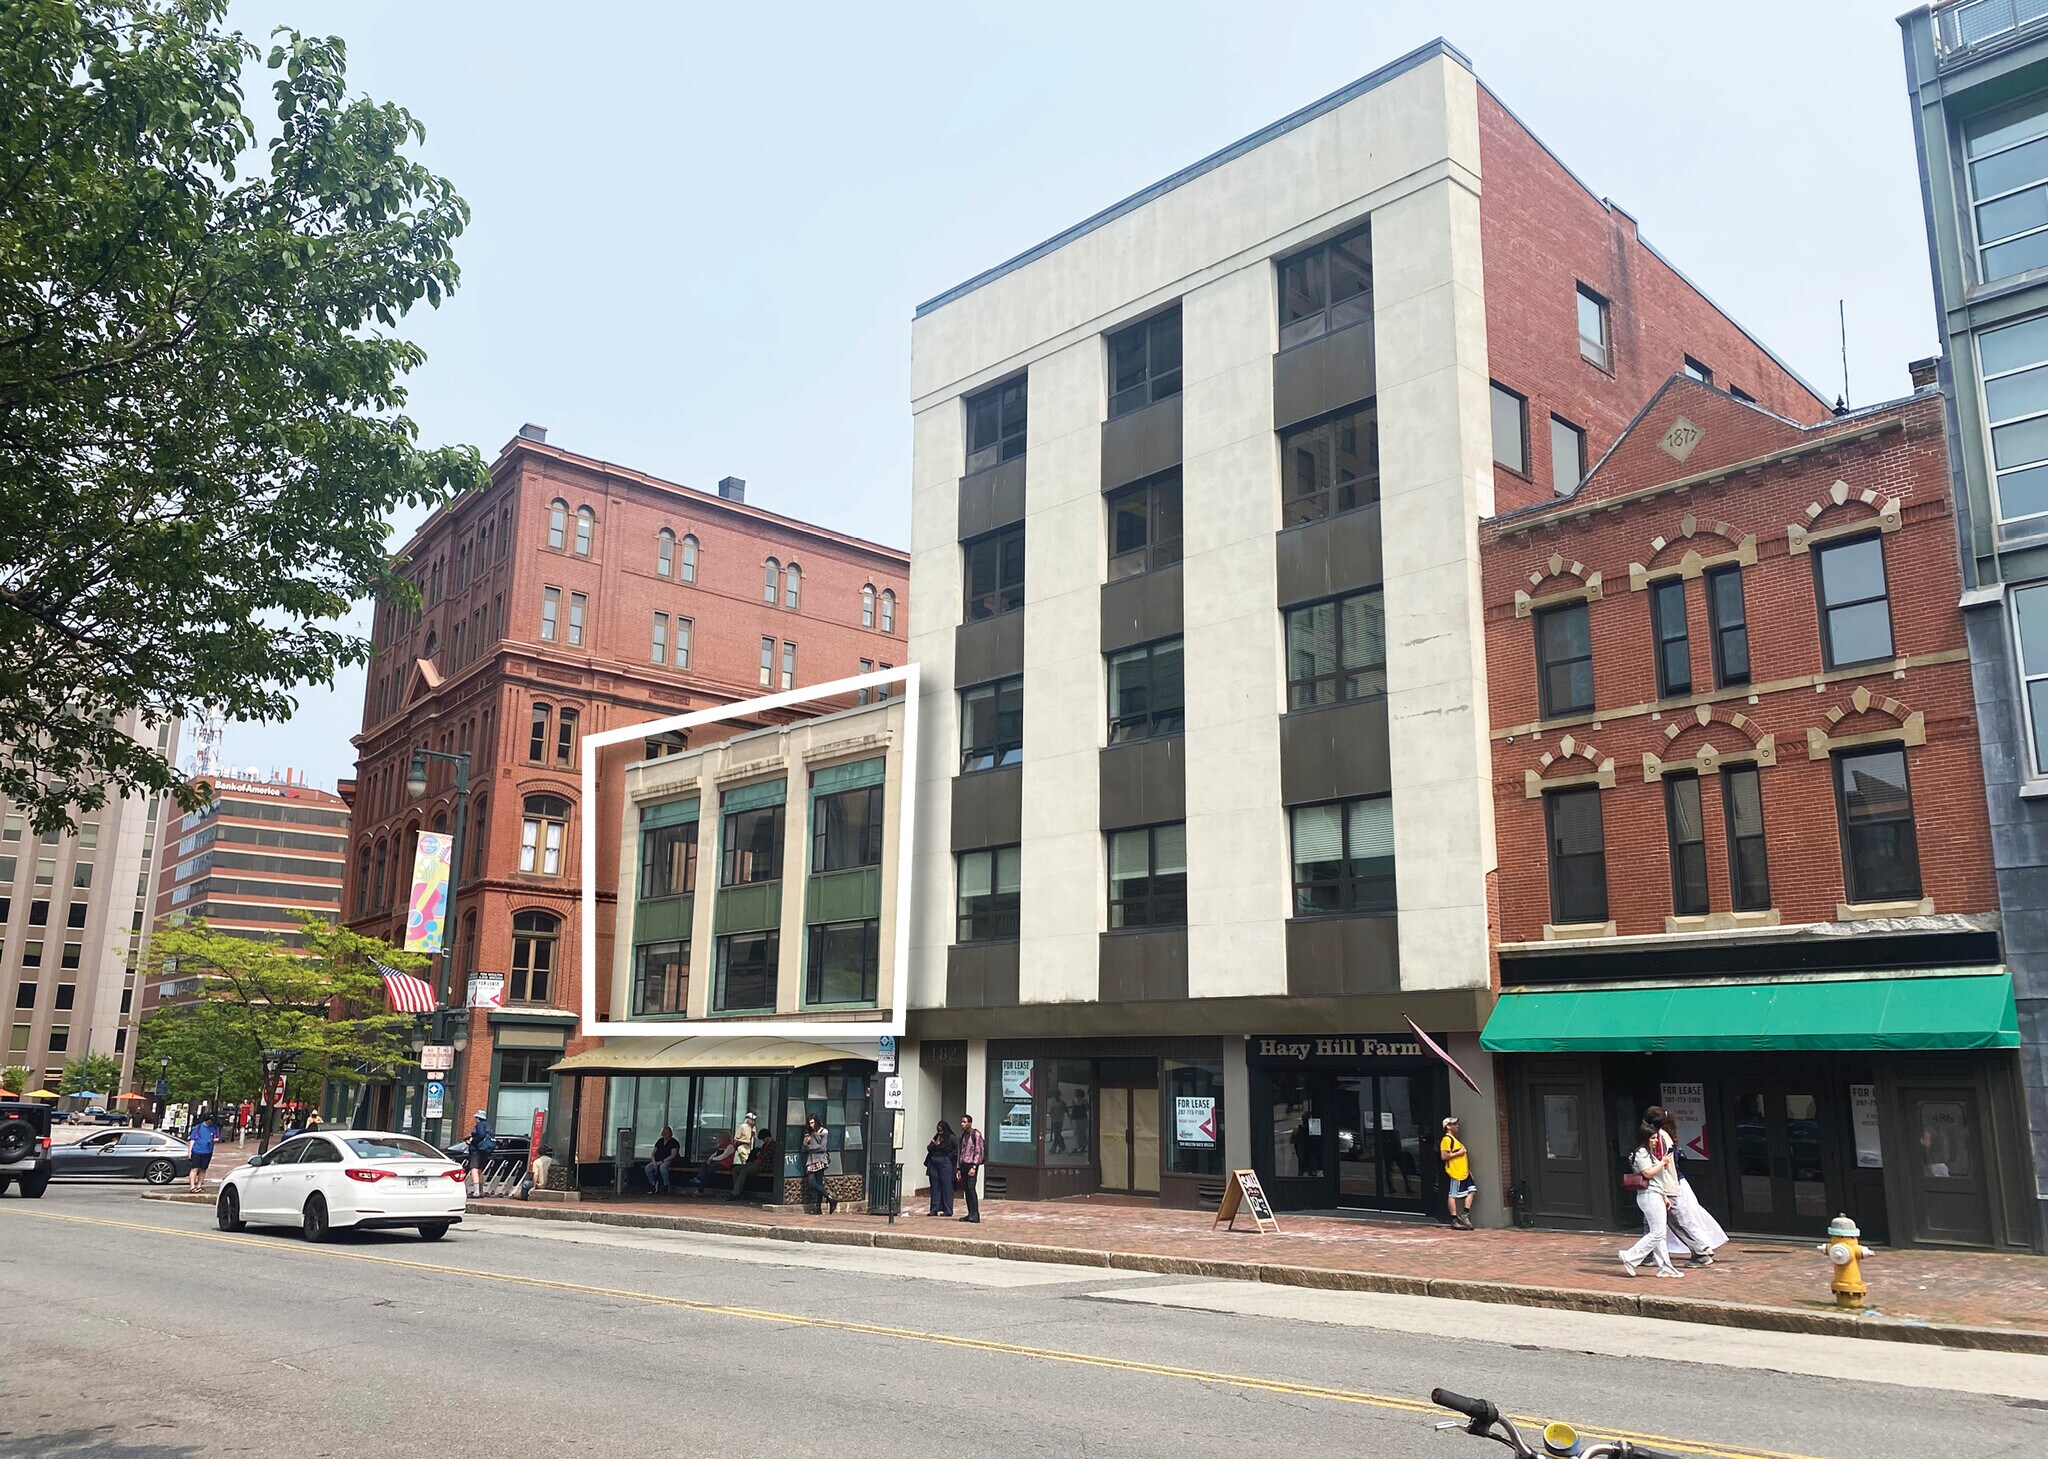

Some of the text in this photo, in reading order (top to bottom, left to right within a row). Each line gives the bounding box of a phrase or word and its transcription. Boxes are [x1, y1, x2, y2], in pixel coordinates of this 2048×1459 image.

[1666, 427, 1698, 448] 1877
[1259, 1038, 1423, 1060] Hazy Hill Farm
[1003, 1061, 1030, 1070] FOR LEASE
[1663, 1086, 1702, 1095] FOR LEASE
[1853, 1088, 1870, 1097] FOR
[1177, 1099, 1210, 1109] FOR LEASE
